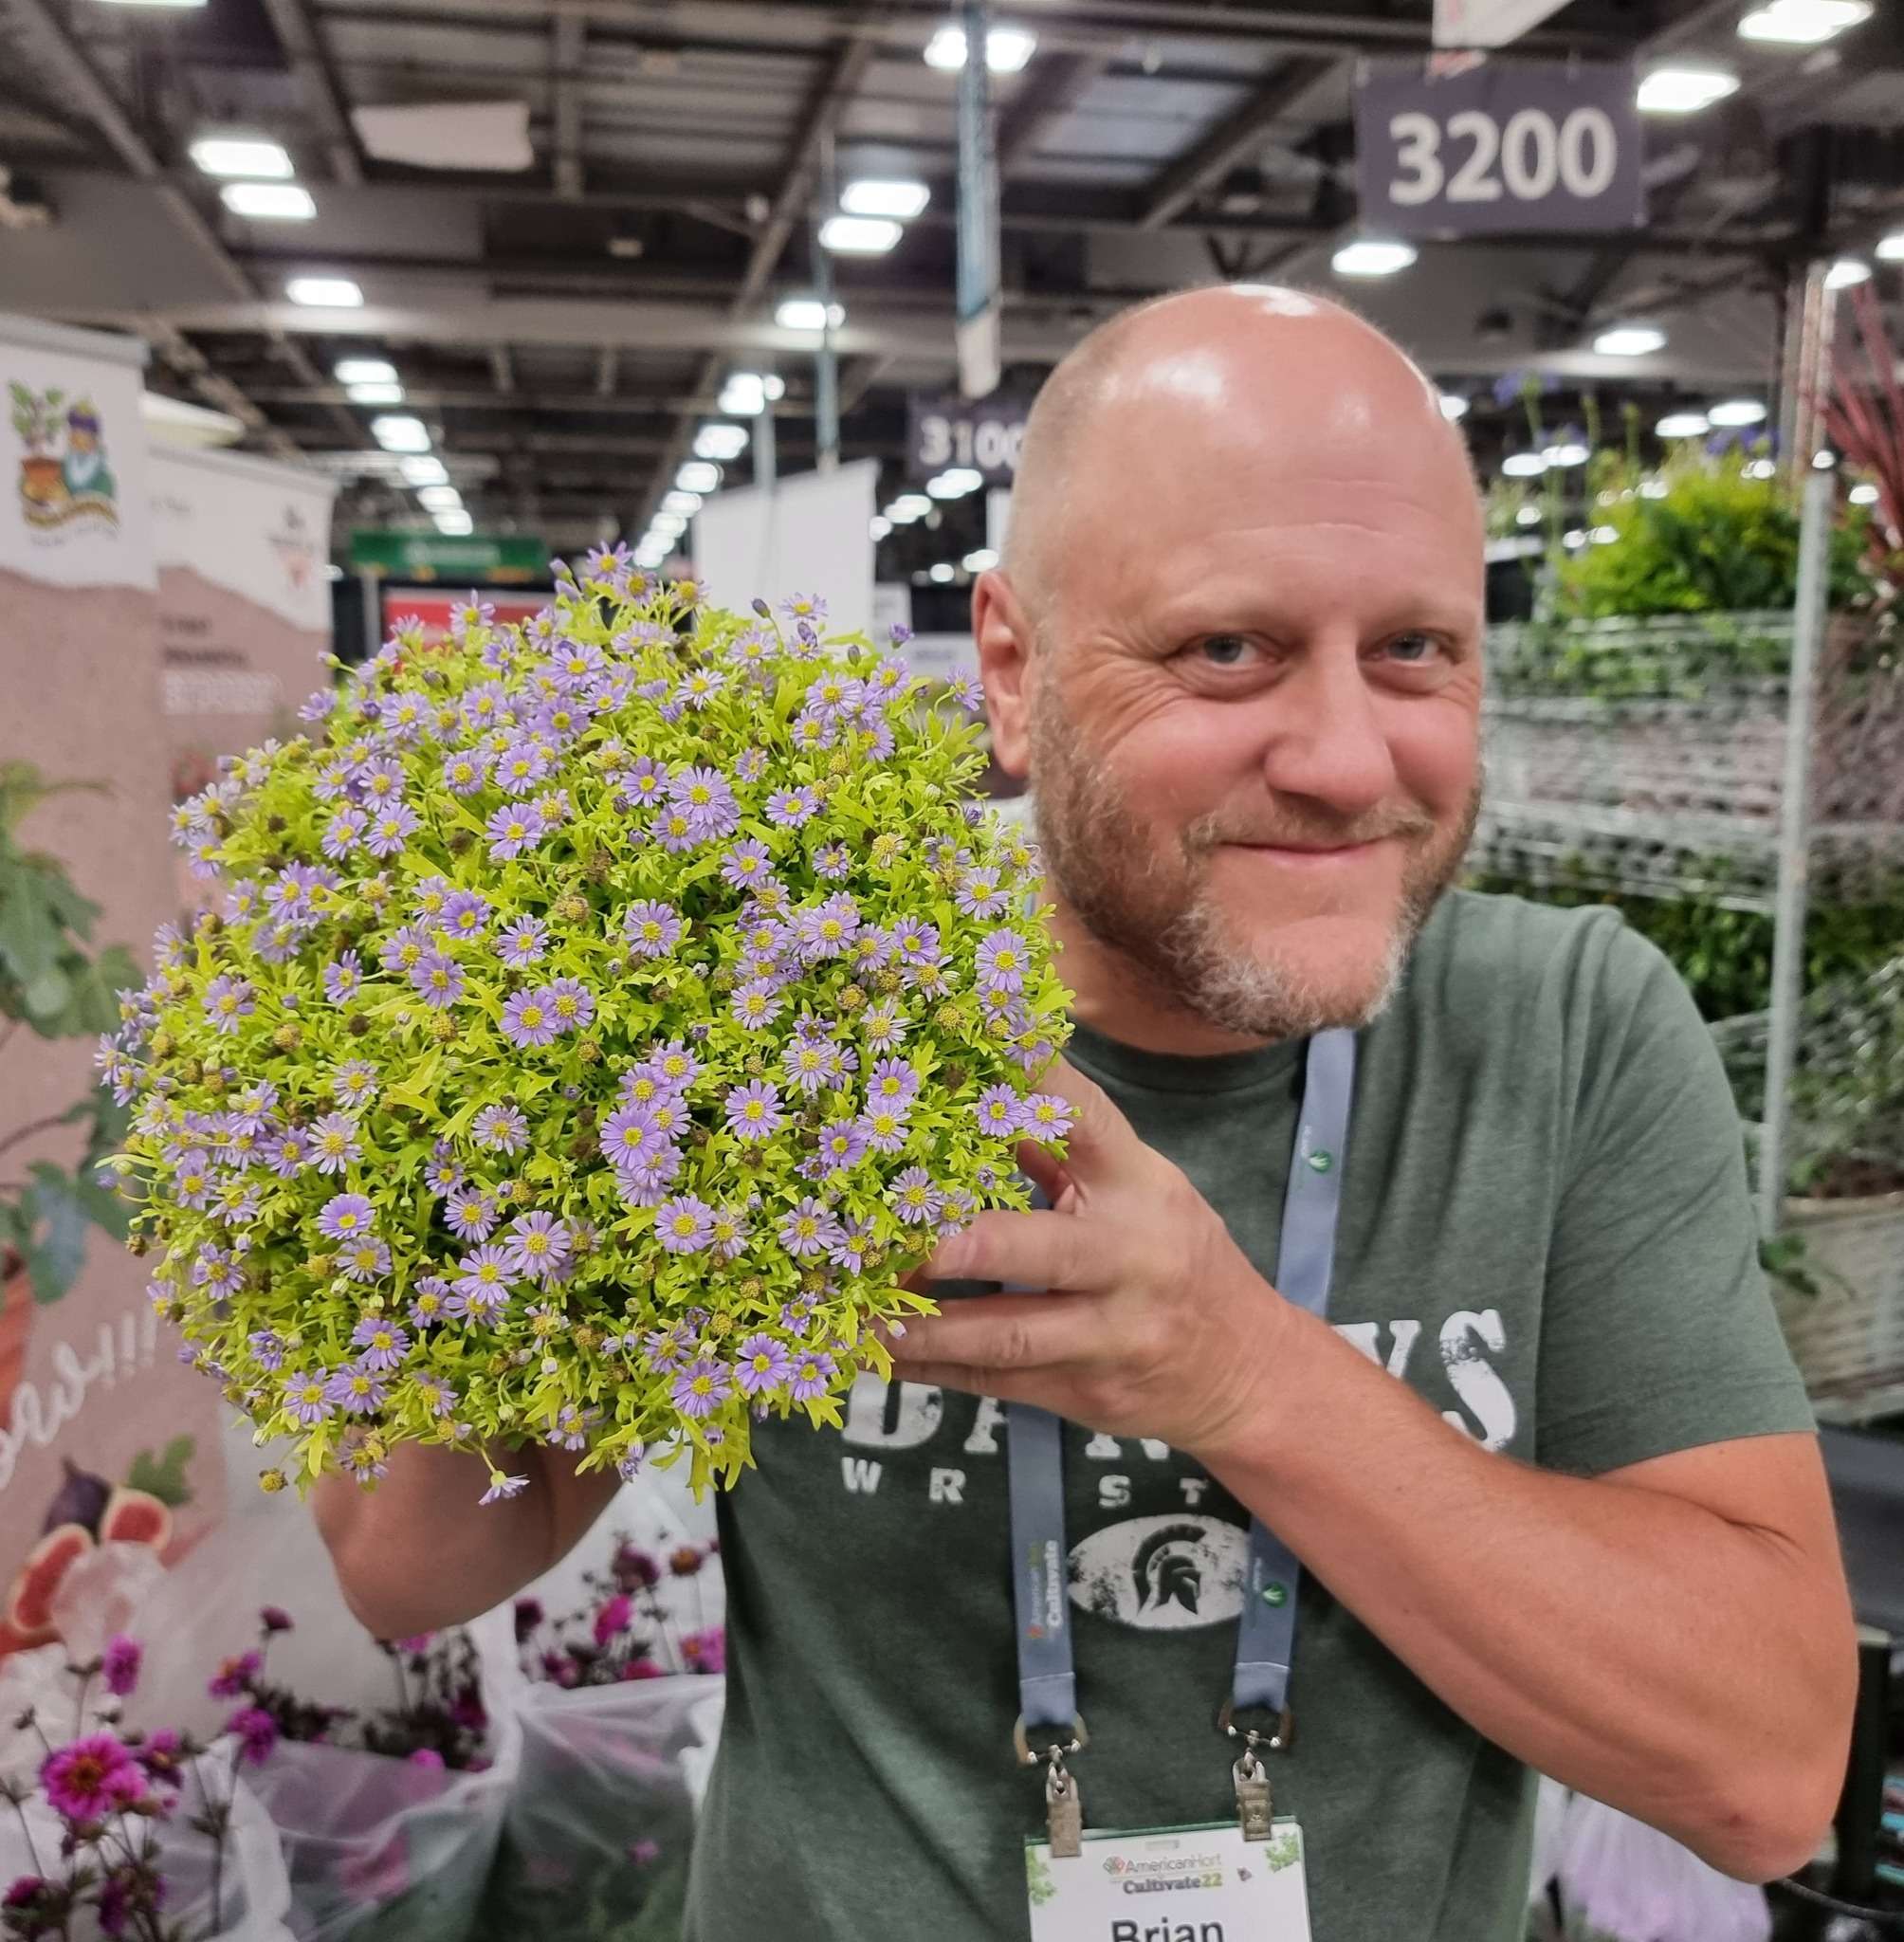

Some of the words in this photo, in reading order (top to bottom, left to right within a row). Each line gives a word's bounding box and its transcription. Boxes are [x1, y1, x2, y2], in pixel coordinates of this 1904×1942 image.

[1388, 105, 1619, 206] 3200
[1126, 1852, 1221, 1874] AmericanHort
[1123, 1872, 1223, 1895] Cultivate22
[1111, 1915, 1225, 1942] Brian
